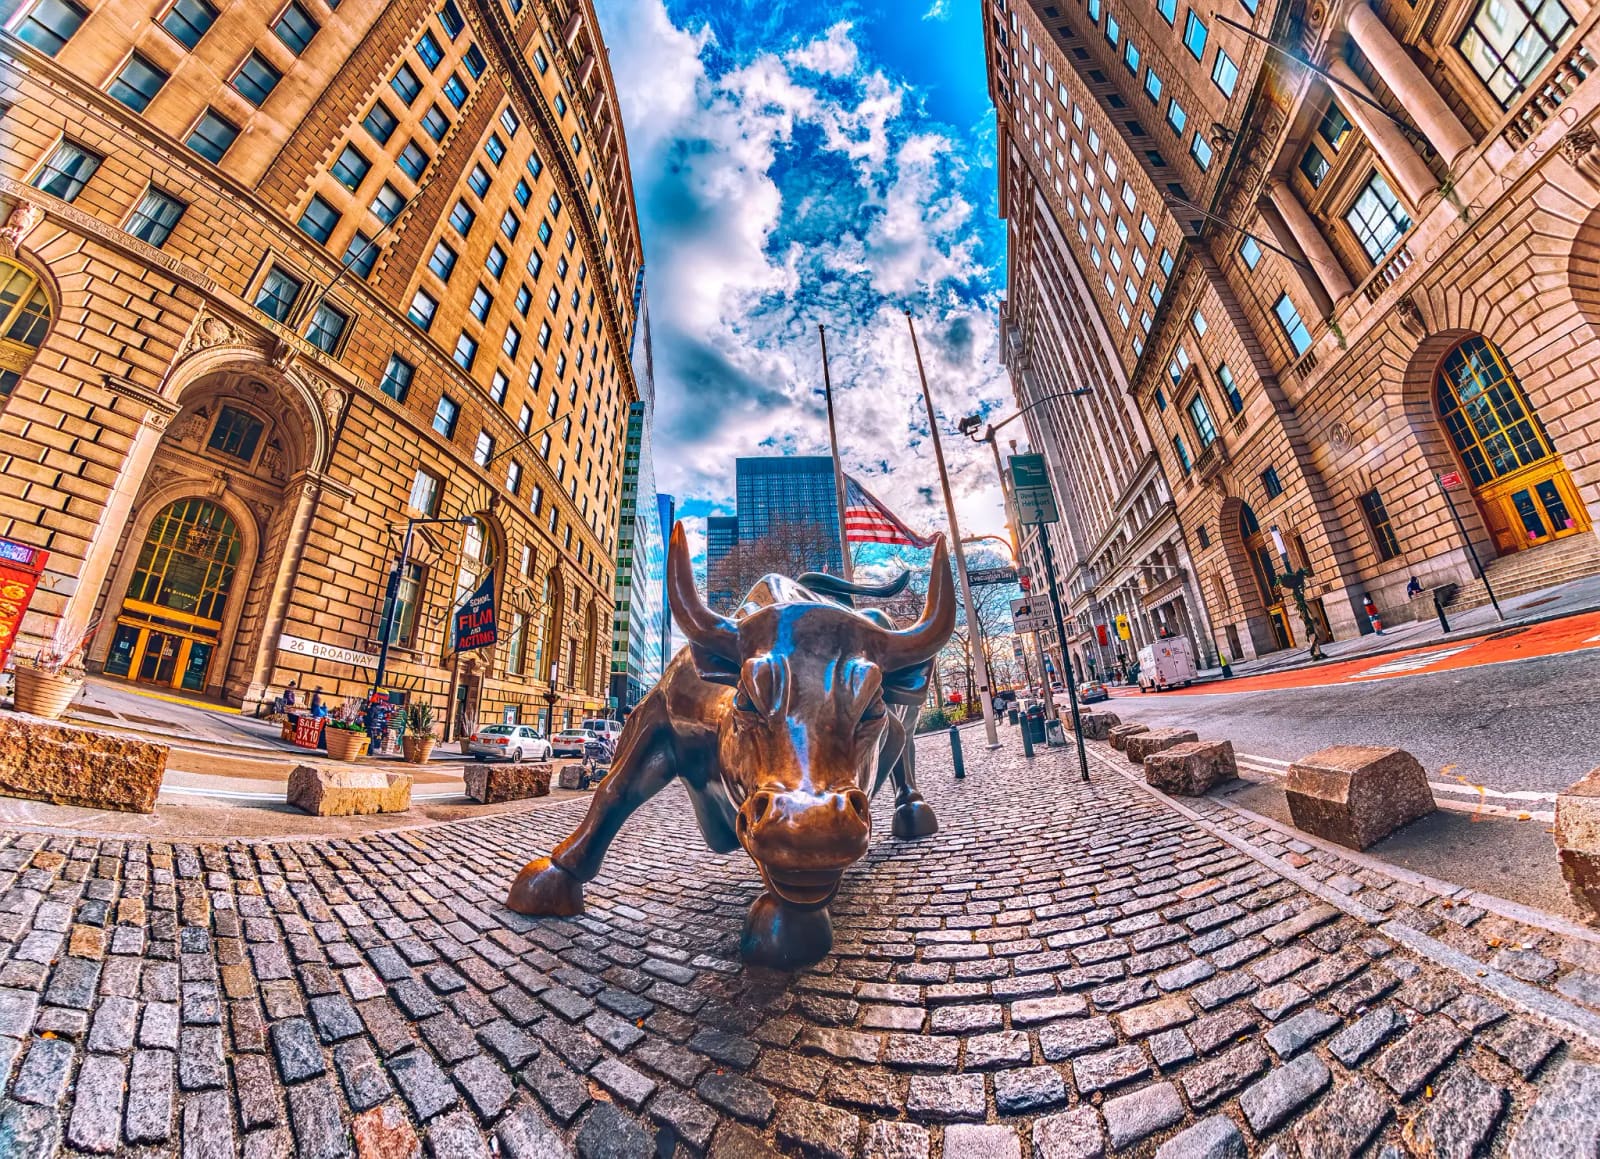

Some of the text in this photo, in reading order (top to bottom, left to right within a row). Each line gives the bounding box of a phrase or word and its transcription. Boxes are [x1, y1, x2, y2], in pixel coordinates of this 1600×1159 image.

[1425, 107, 1578, 262] CUNARD
[459, 608, 493, 630] FILM
[459, 631, 495, 648] ACTING
[290, 640, 373, 665] 26 BROADWAY
[299, 718, 321, 730] SALE
